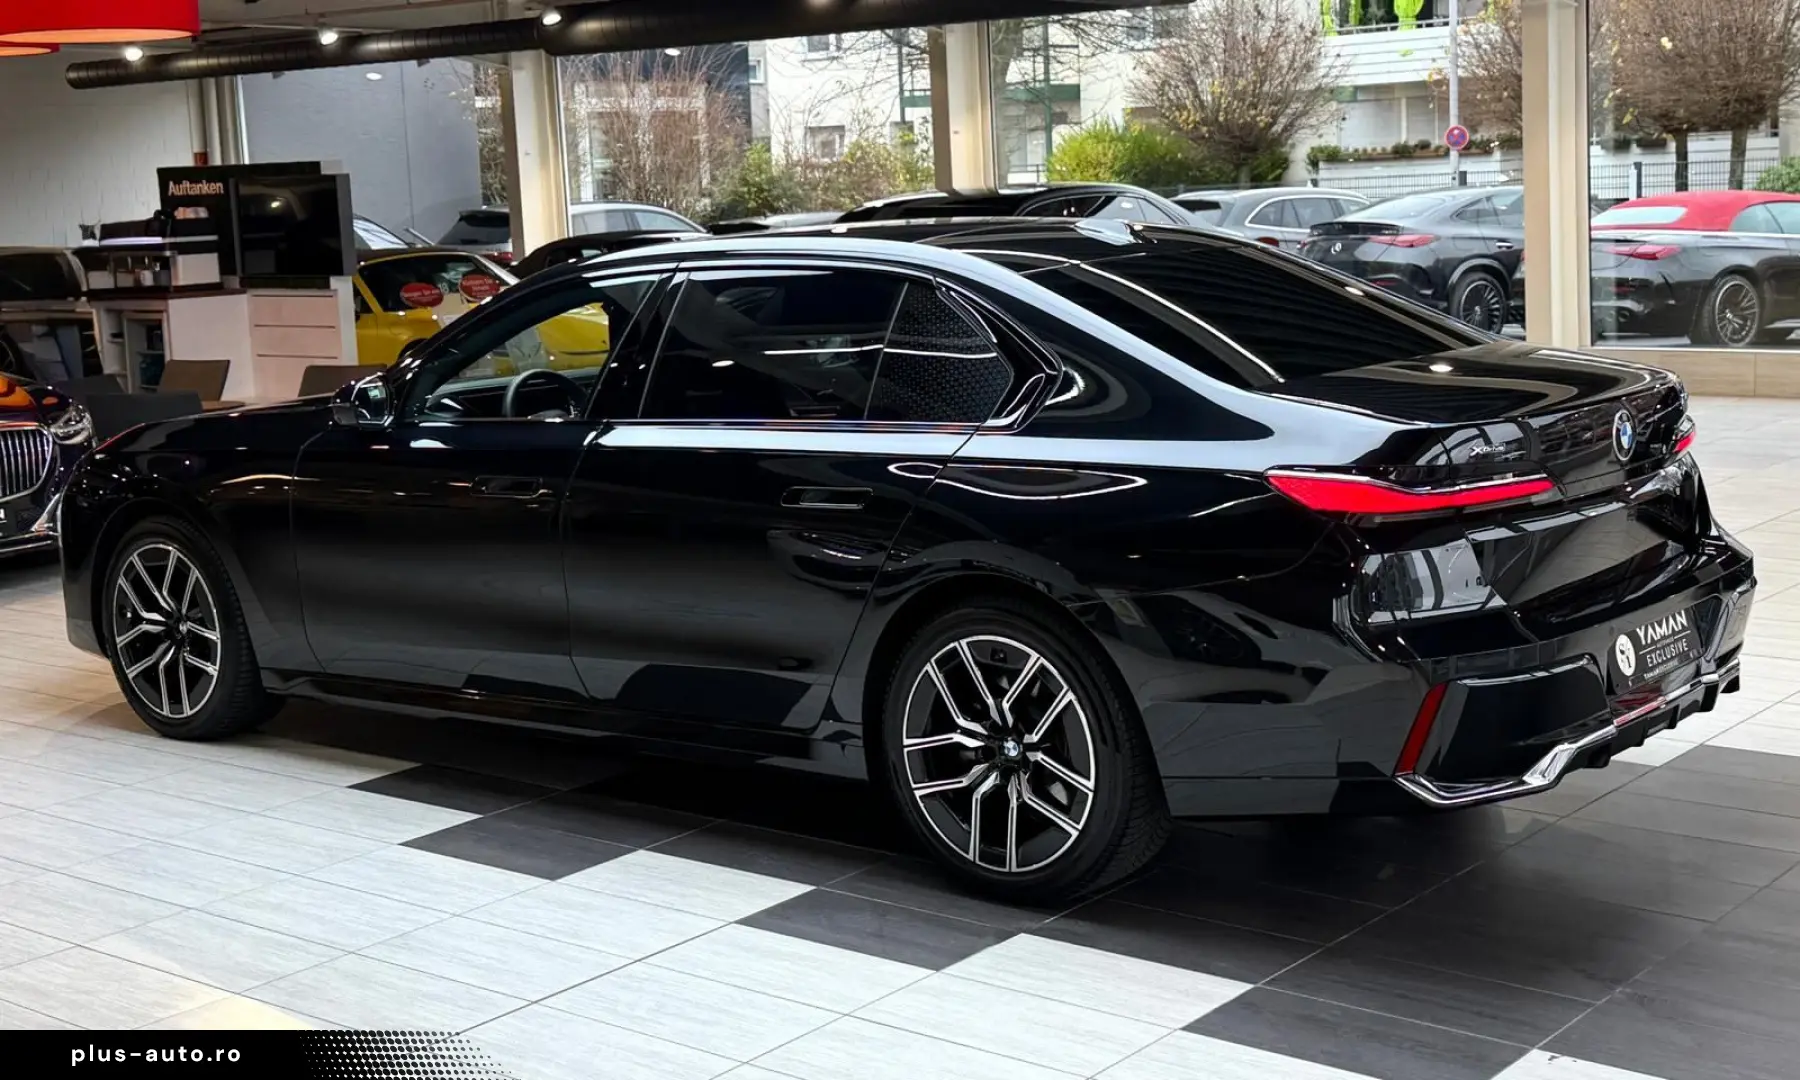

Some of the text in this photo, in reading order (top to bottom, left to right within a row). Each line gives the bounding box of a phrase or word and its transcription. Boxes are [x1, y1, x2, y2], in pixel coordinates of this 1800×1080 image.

[168, 180, 224, 196] Auftanken
[1636, 609, 1688, 646] YAMAN
[1646, 638, 1689, 667] EXCLUSIVE
